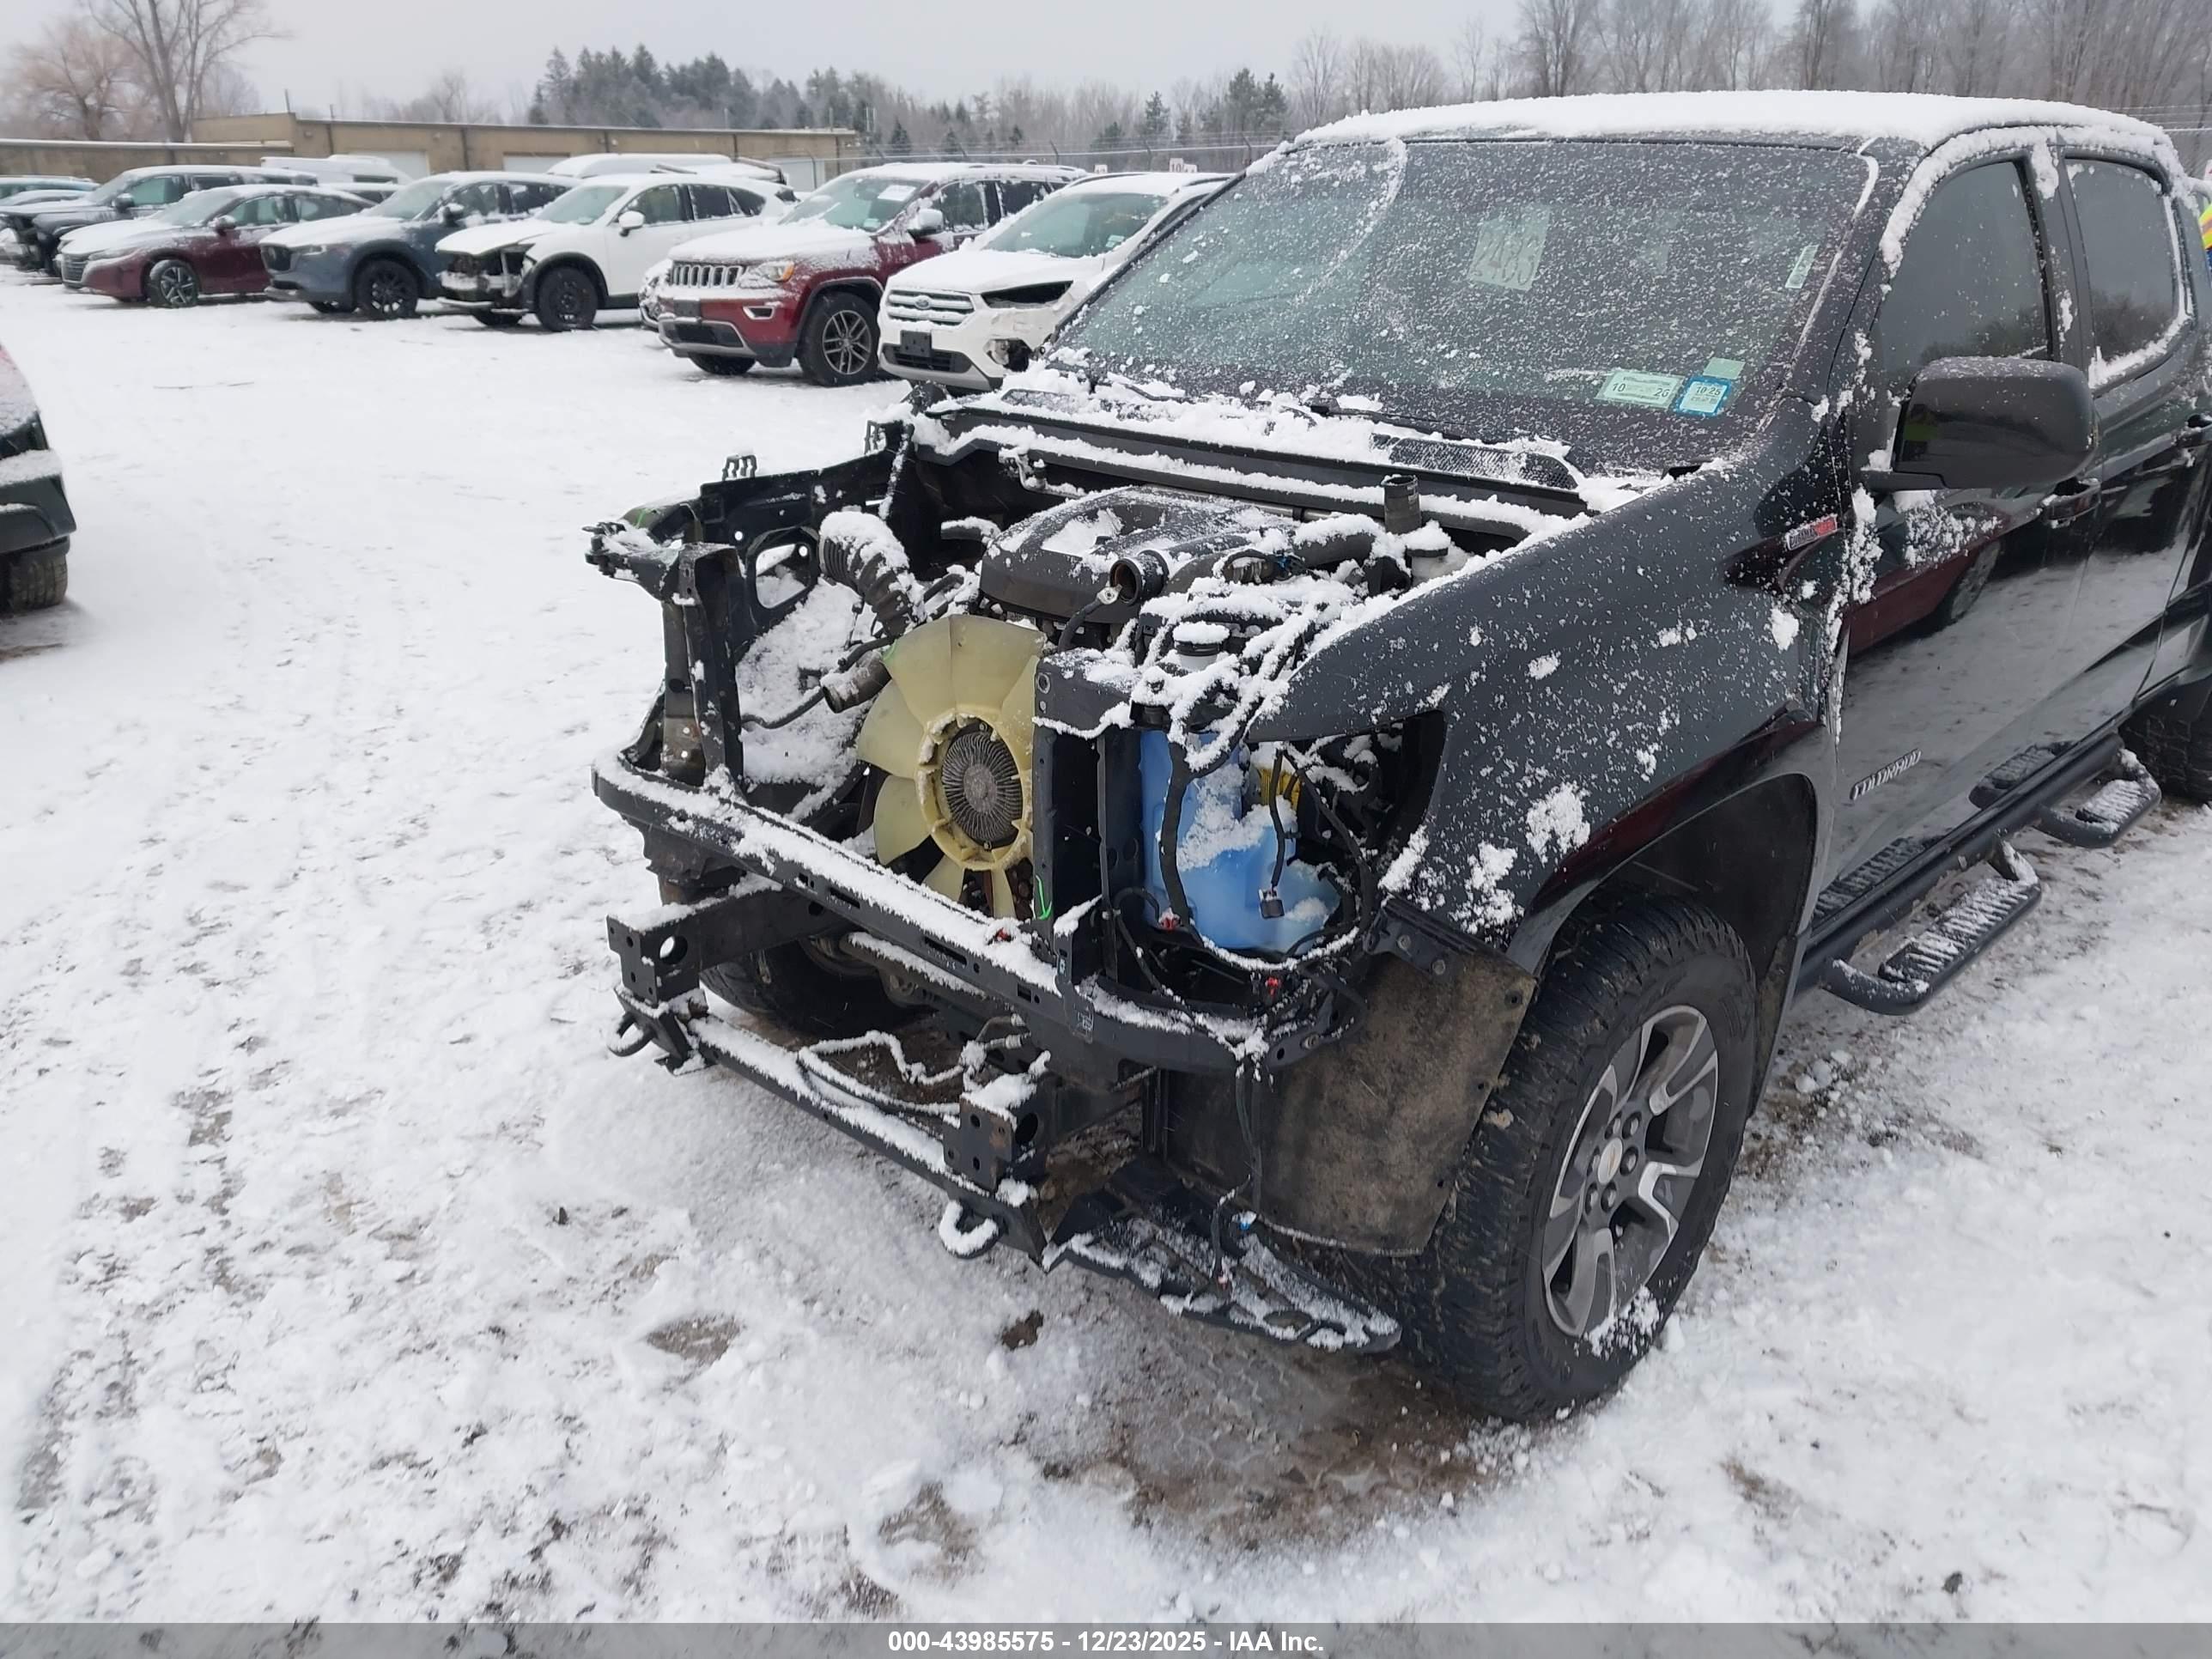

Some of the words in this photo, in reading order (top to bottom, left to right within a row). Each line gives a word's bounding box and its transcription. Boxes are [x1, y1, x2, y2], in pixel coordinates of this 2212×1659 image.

[1613, 383, 1626, 392] 10
[1696, 386, 1708, 394] 10
[1709, 386, 1722, 396] 25
[1852, 749, 1922, 800] COLORADO
